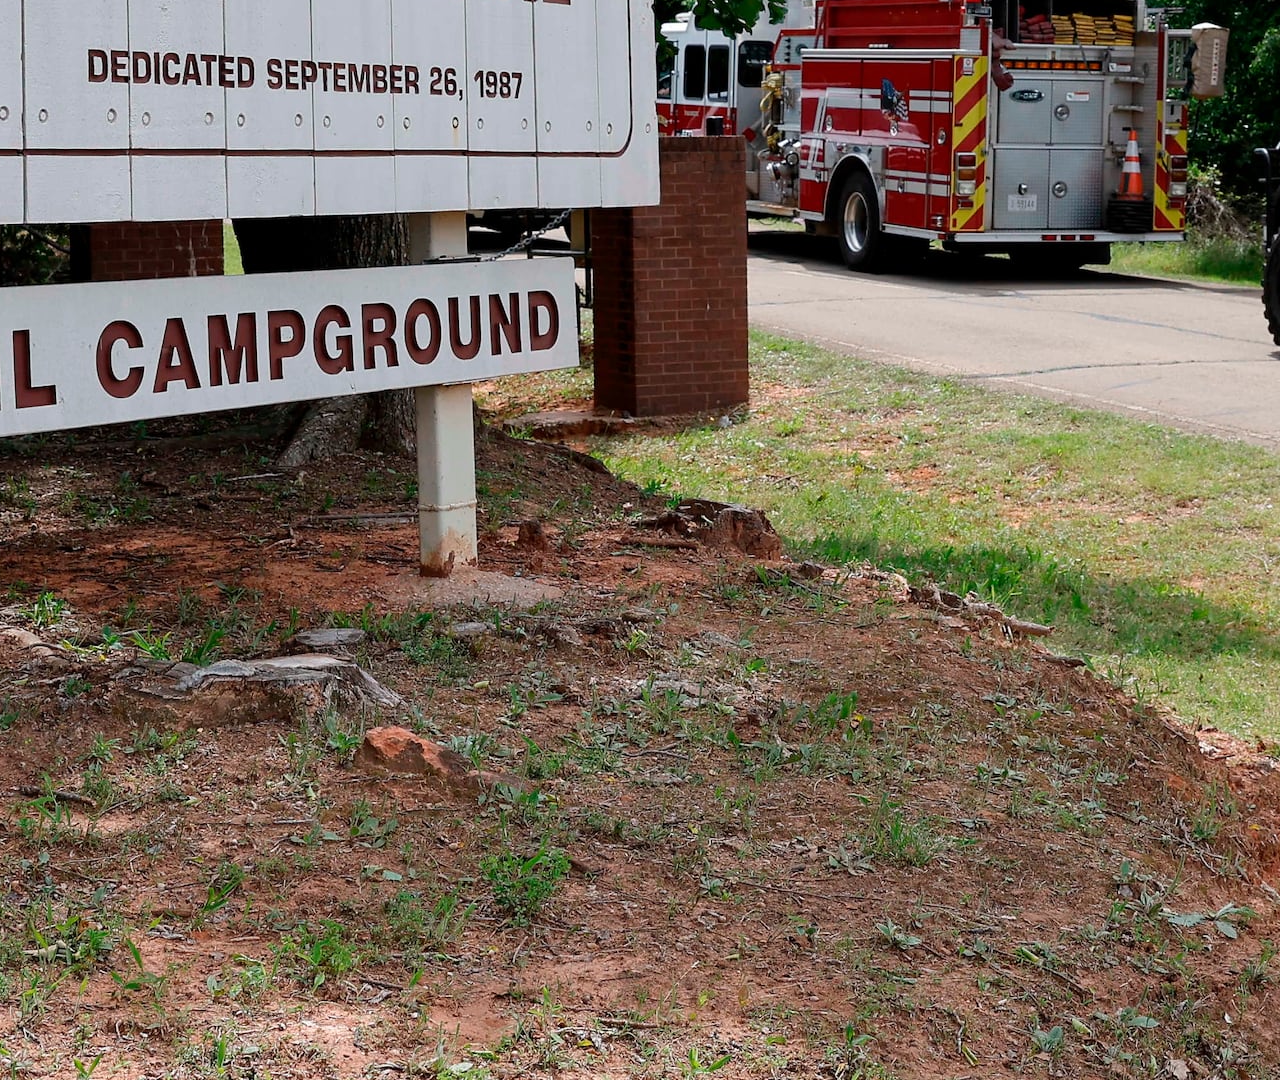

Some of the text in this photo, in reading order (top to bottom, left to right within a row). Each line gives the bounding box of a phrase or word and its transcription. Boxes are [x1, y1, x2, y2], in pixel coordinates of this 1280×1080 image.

[87, 48, 523, 102] DEDICATED SEPTEMBER 26, 1987
[96, 289, 560, 399] CAMPGROUND
